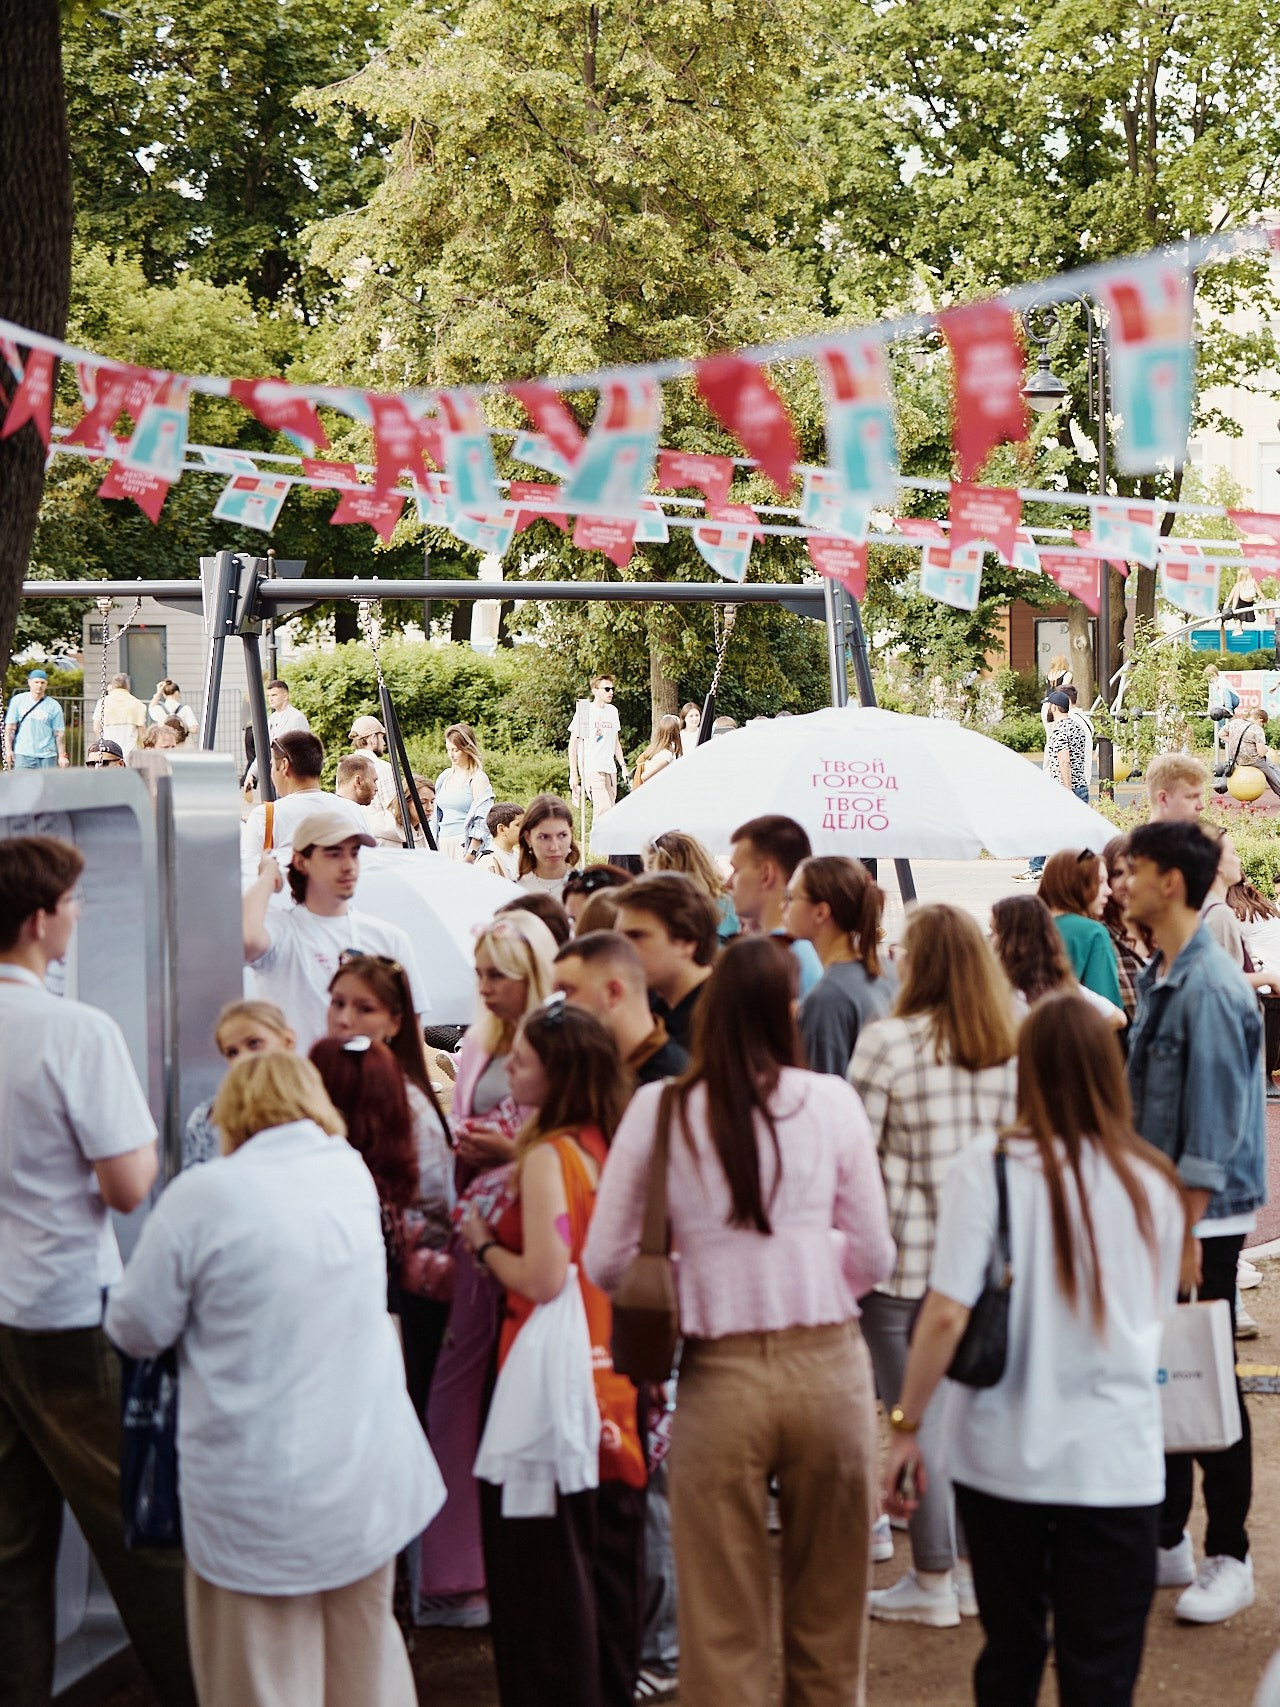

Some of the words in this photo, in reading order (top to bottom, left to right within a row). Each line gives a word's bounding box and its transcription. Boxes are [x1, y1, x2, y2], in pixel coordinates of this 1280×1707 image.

[821, 758, 885, 774] ТВОЙ
[812, 774, 899, 791] ГОРОД
[824, 795, 888, 812] ТВОЁ
[822, 813, 889, 832] ДЕЛО
